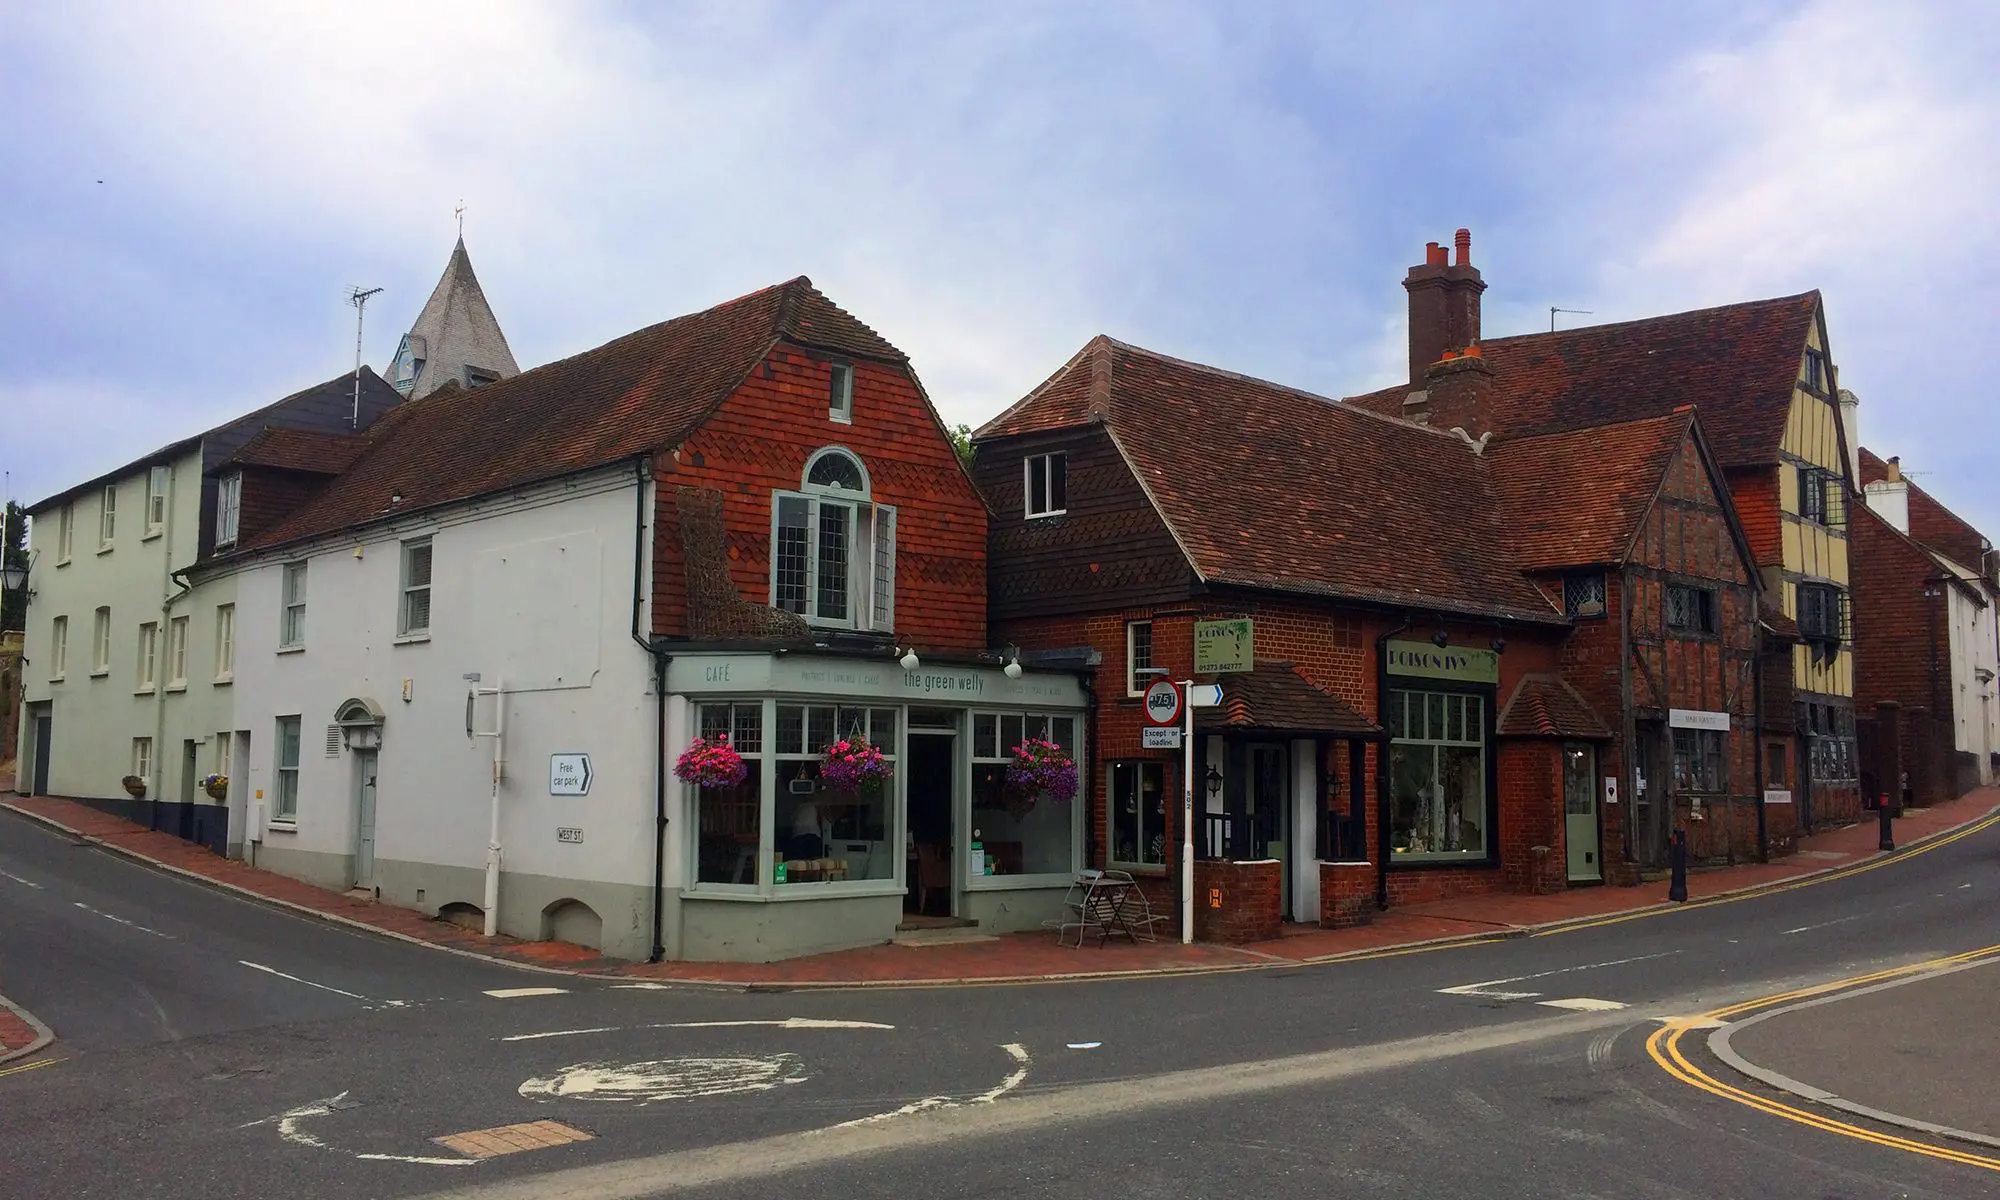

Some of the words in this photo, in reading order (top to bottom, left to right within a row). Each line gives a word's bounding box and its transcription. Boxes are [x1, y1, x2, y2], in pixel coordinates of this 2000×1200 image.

[706, 664, 730, 682] CAFÉ
[904, 673, 920, 688] the
[925, 675, 954, 693] green
[958, 673, 984, 695] welly
[1144, 729, 1167, 738] Except
[1149, 739, 1173, 747] loading
[560, 762, 573, 772] Free
[553, 778, 564, 786] car
[564, 777, 579, 787] park
[559, 830, 572, 840] WEST
[573, 830, 581, 840] ST
